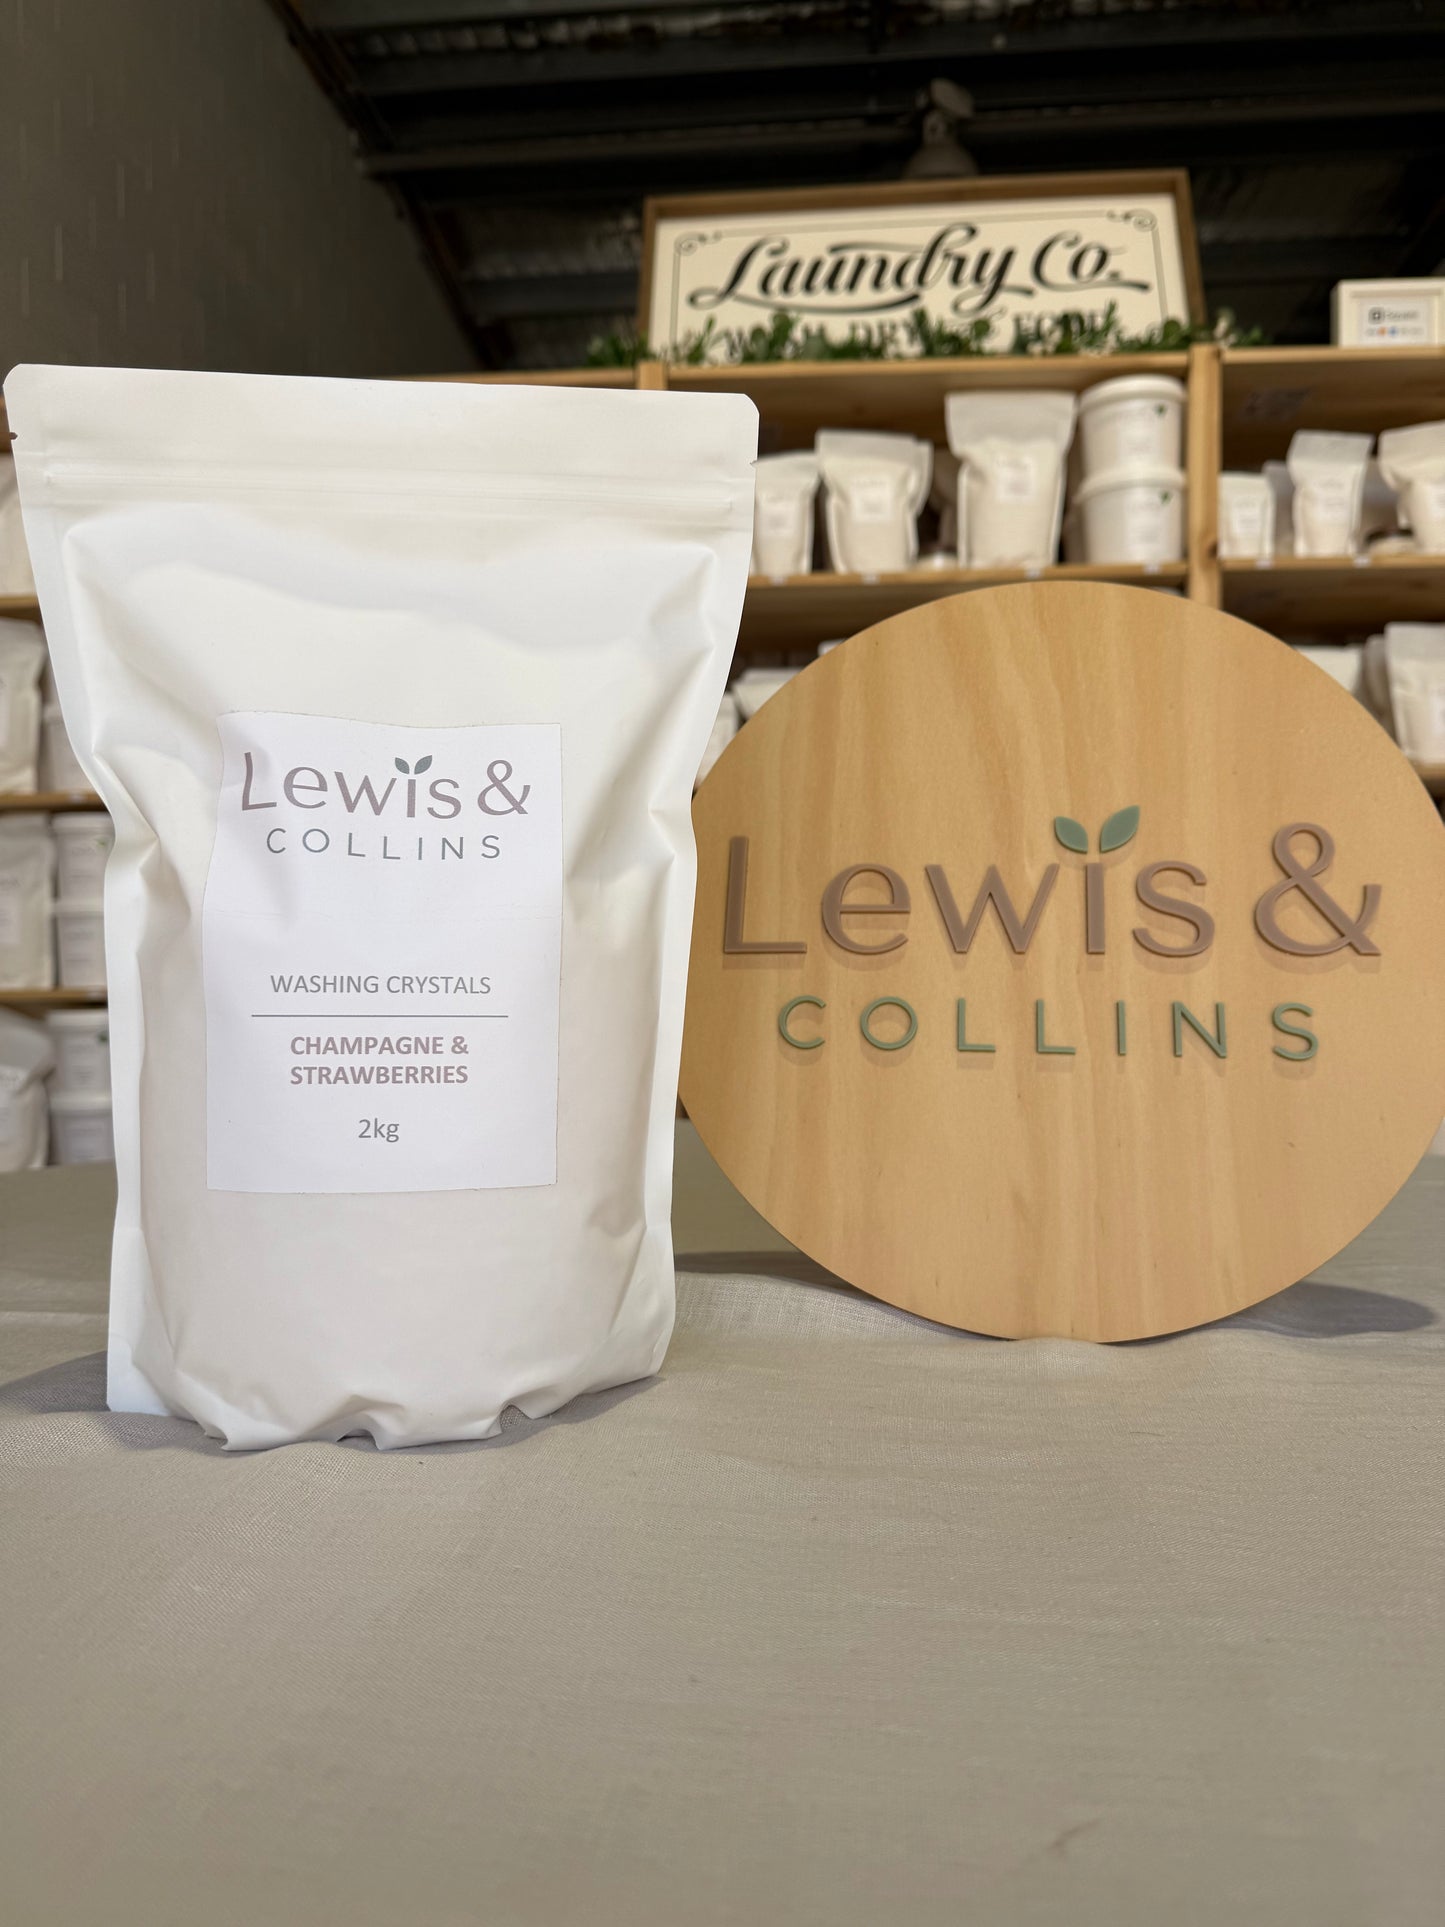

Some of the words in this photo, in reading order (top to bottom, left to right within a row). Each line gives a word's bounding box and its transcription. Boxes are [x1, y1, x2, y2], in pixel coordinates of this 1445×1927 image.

[690, 223, 1034, 319] Laundry
[1031, 230, 1150, 297] Co.
[241, 752, 461, 819] Lewis
[477, 759, 530, 815] &
[266, 827, 500, 860] COLLINS
[723, 805, 1215, 957] Lewis
[1254, 822, 1382, 957] &
[270, 974, 380, 995] WASHING
[386, 975, 491, 995] CRYSTALS
[778, 995, 1320, 1061] COLLINS
[290, 1035, 444, 1056] CHAMPAGNE
[450, 1035, 470, 1056] &
[290, 1064, 469, 1086] STRAWBERRIES
[358, 1117, 401, 1143] 2kg
